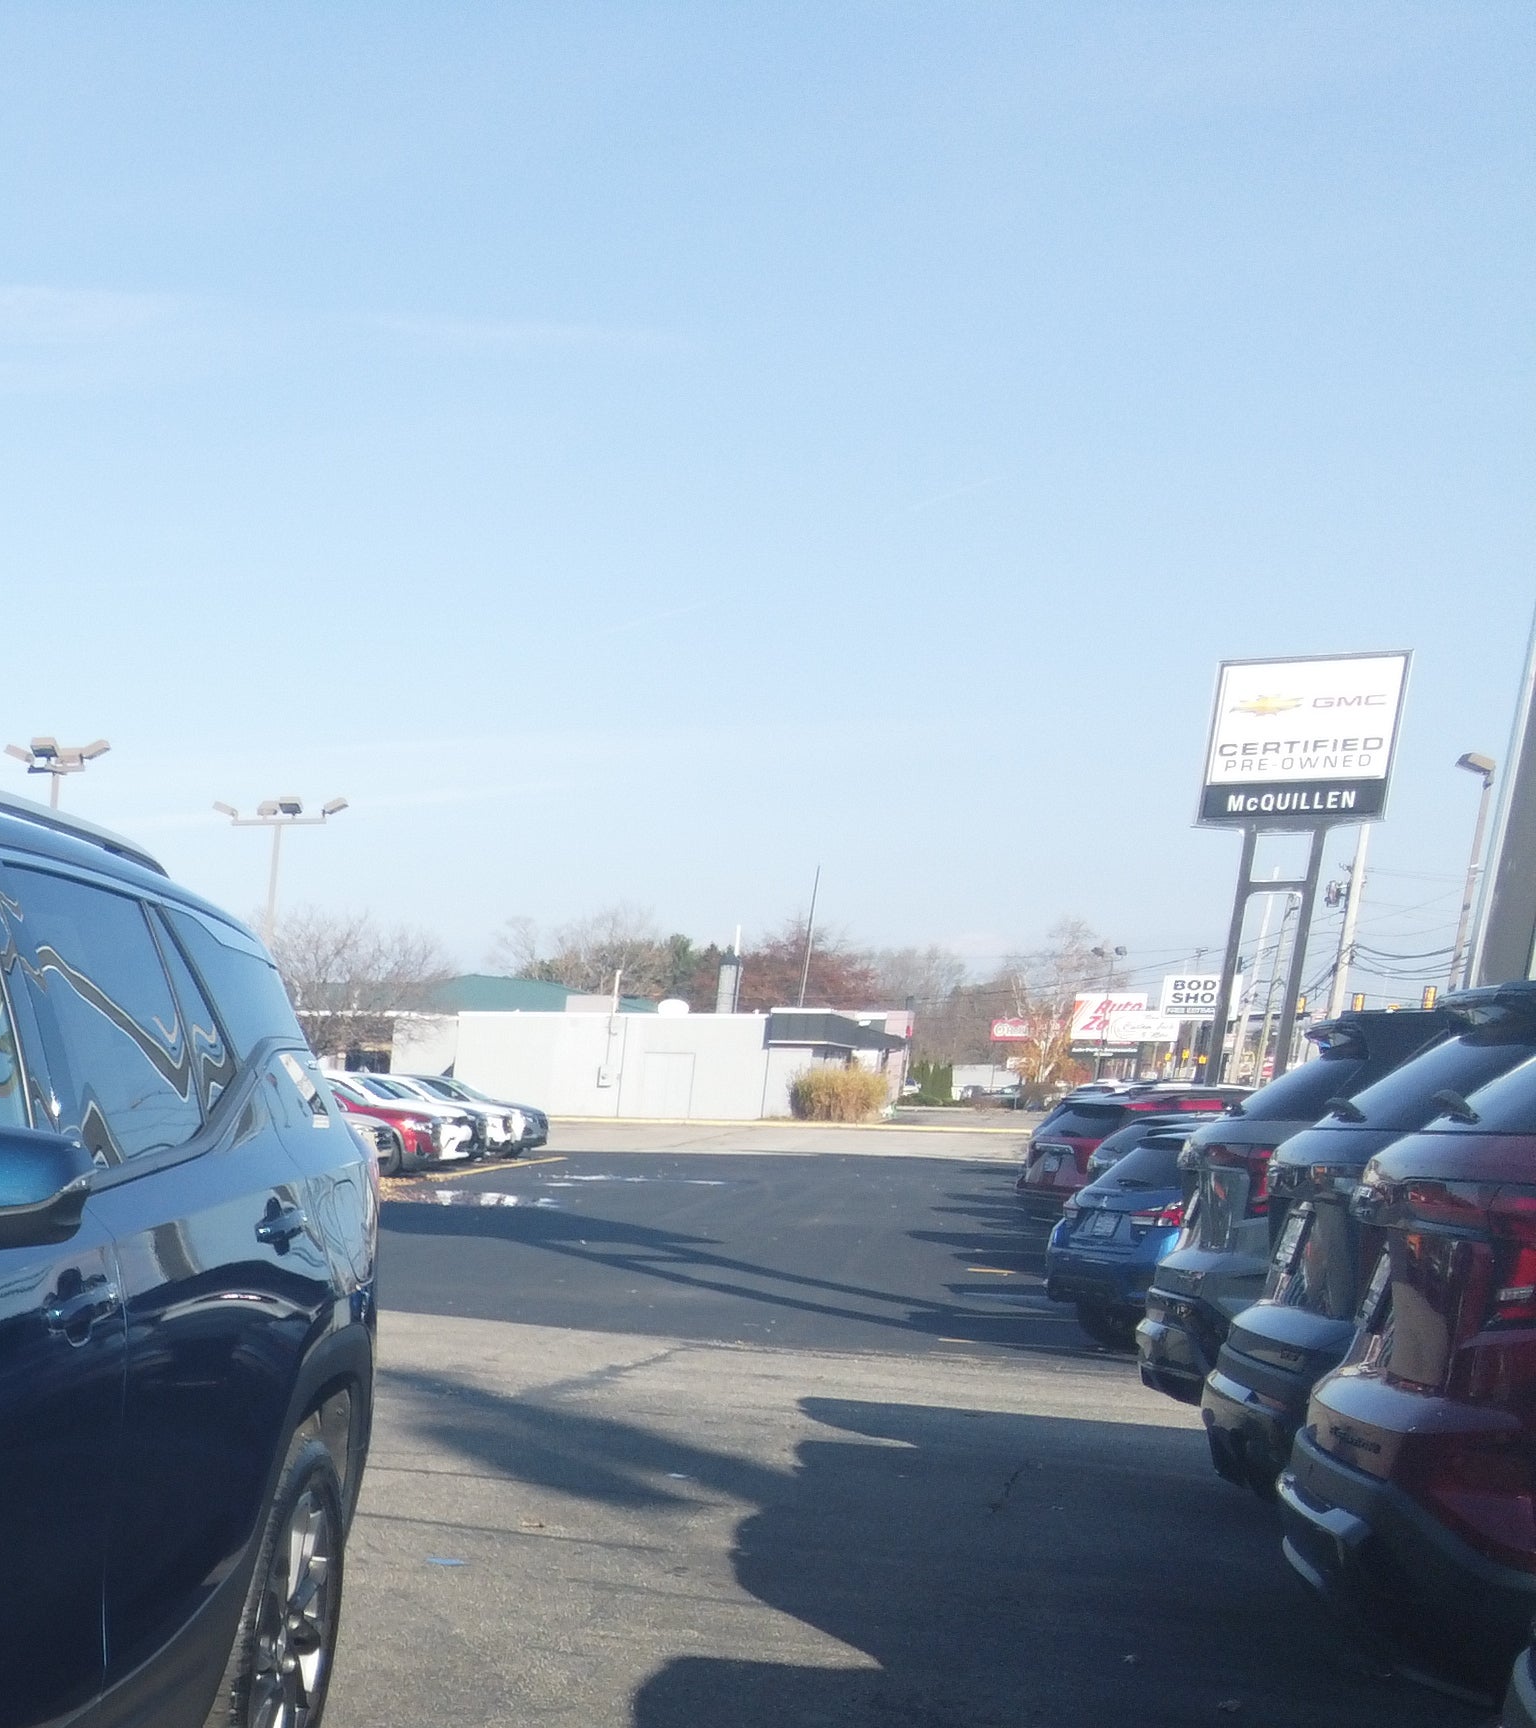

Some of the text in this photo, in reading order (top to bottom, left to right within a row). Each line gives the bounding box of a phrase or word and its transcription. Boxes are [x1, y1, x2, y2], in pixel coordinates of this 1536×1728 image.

[1312, 694, 1387, 709] GMC
[1218, 737, 1384, 757] CERTIFIED
[1224, 754, 1371, 772] PRE-OWNED
[1227, 791, 1356, 812] McQUILLEN
[1173, 979, 1221, 992] BOD
[1171, 992, 1216, 1004] SHO
